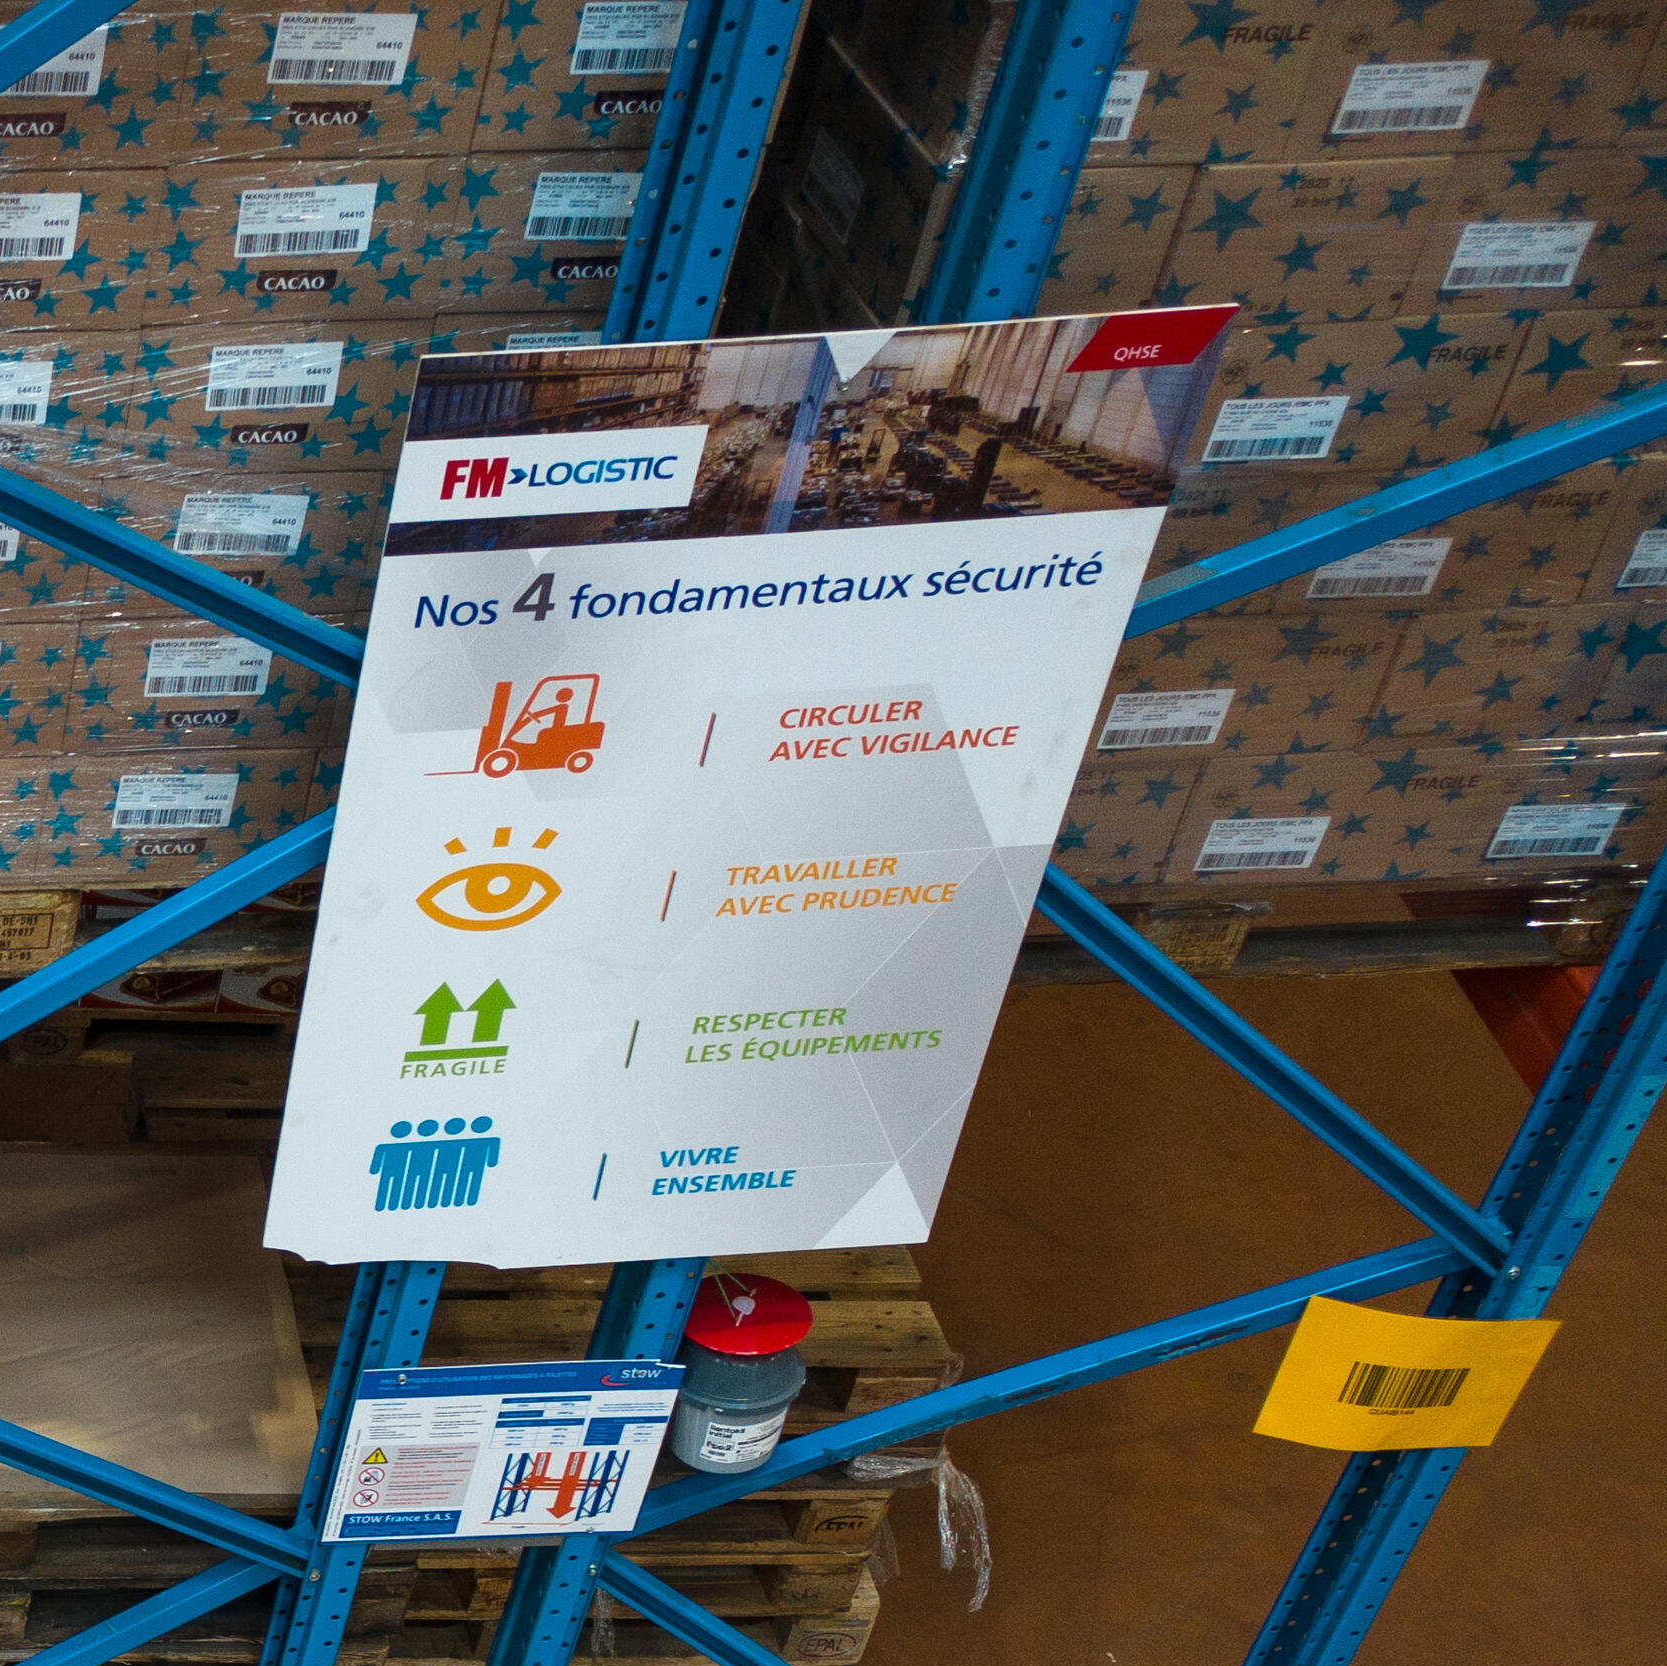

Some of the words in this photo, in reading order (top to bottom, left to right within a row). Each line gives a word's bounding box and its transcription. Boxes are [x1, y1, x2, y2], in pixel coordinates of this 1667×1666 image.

[1223, 23, 1313, 44] FRAGILE
[600, 99, 663, 115] CACAO
[295, 111, 358, 126] CACAO
[557, 265, 619, 279] CACAO
[264, 276, 325, 290] CACAO
[1113, 343, 1163, 362] QHSE
[1427, 344, 1508, 363] FRAGILE
[238, 430, 298, 444] CACAO
[439, 457, 510, 501] FM
[528, 455, 678, 487] LOGISTIC
[413, 595, 498, 629] Nos
[512, 572, 555, 622] 4
[568, 571, 910, 621] fondamentaux
[923, 550, 1104, 596] sécurité
[170, 712, 228, 725] CACAO
[779, 700, 923, 730] CIRCULER
[768, 734, 852, 763] AVEC
[859, 725, 1020, 757] VIGILANCE
[1404, 773, 1481, 794] FRAGILE
[140, 843, 196, 855] CACAO
[726, 857, 898, 886] TRAVAILLER
[715, 890, 796, 918] AVEC
[801, 882, 958, 913] PRUDENCE
[691, 1007, 848, 1035] RESPECTER
[684, 1041, 737, 1065] LES
[740, 1029, 944, 1062] ÉQUIPEMENTS
[399, 1058, 509, 1080] FRAGILE
[658, 1145, 740, 1170] VIVRE
[649, 1169, 797, 1197] ENSEMBLE
[620, 1367, 662, 1379] stow
[348, 1515, 383, 1525] STOW
[384, 1514, 421, 1524] France
[422, 1512, 454, 1522] S.A.S.
